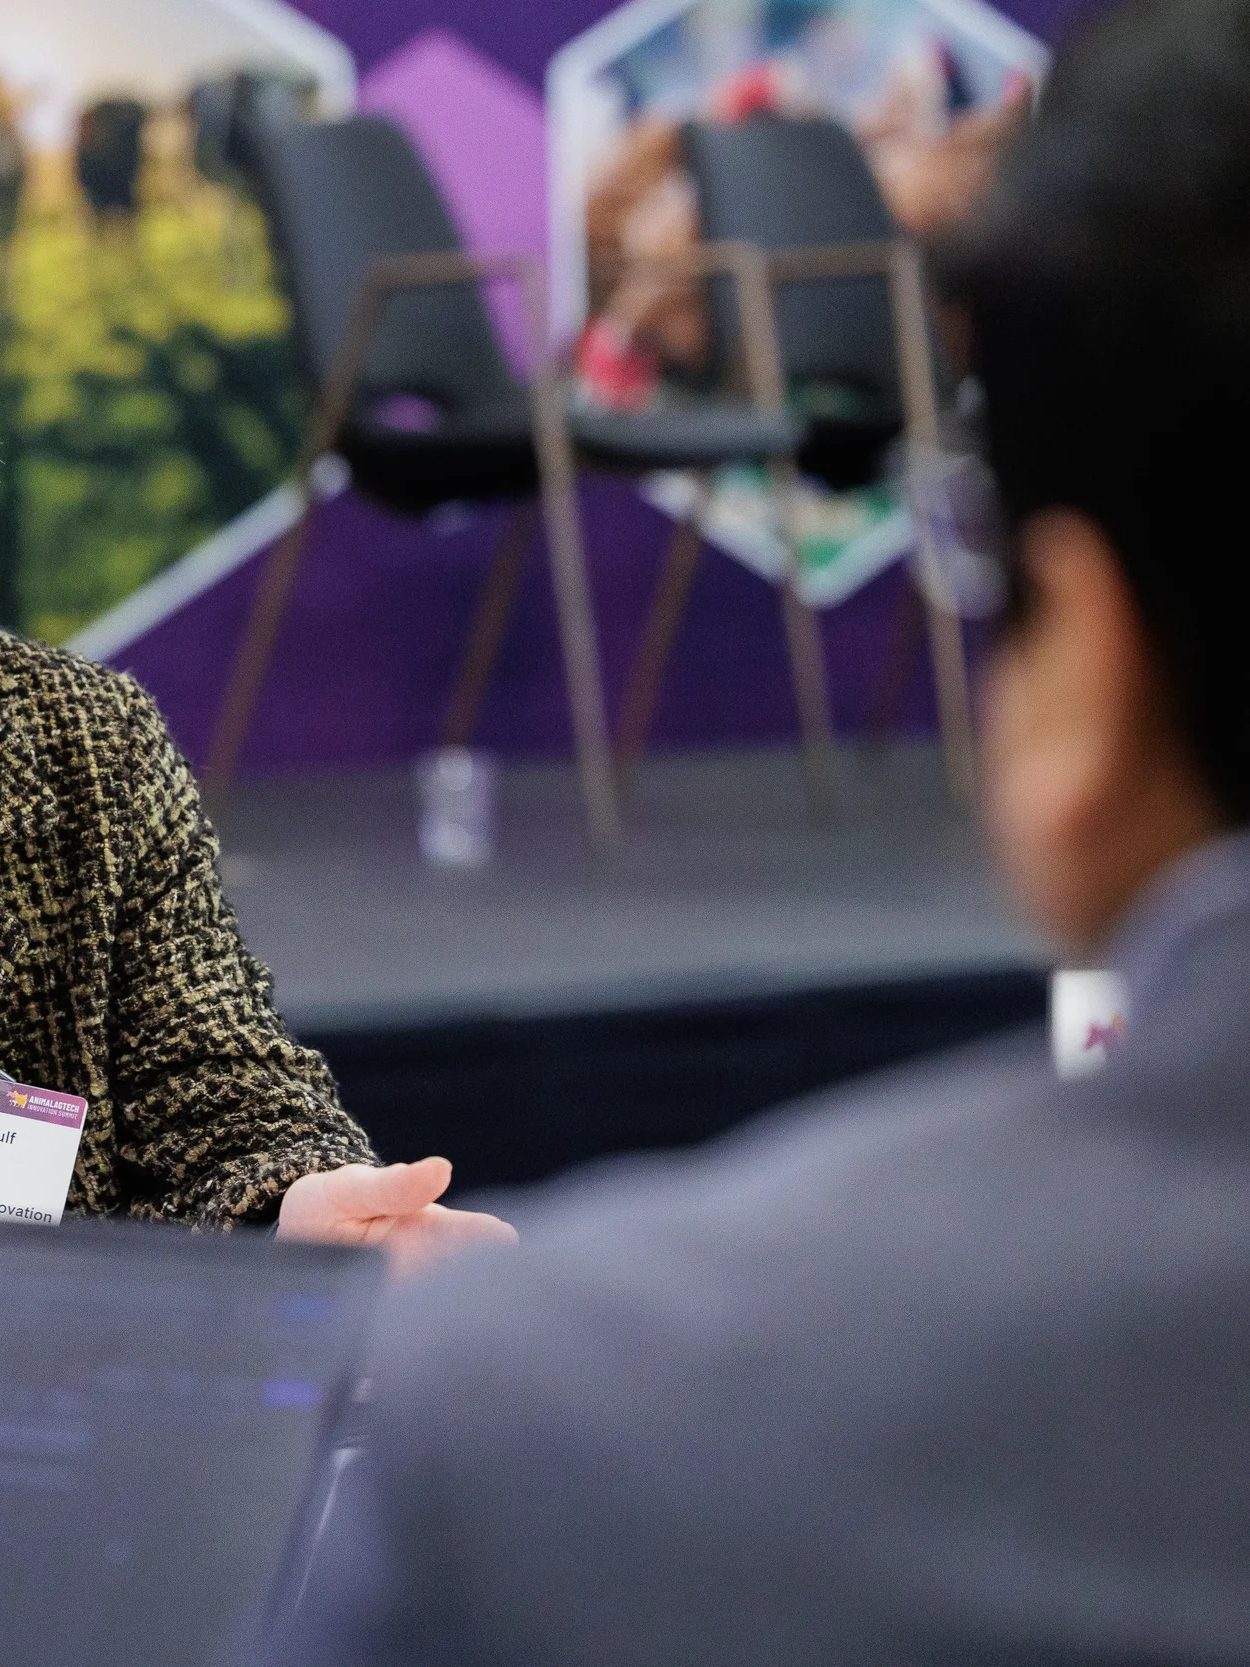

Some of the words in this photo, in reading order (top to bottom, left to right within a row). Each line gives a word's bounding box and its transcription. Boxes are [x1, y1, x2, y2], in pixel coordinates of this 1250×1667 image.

[27, 1103, 58, 1116] INNOVATION
[57, 1110, 78, 1120] SUMMIT
[28, 1096, 80, 1113] ANIMALAGTECH
